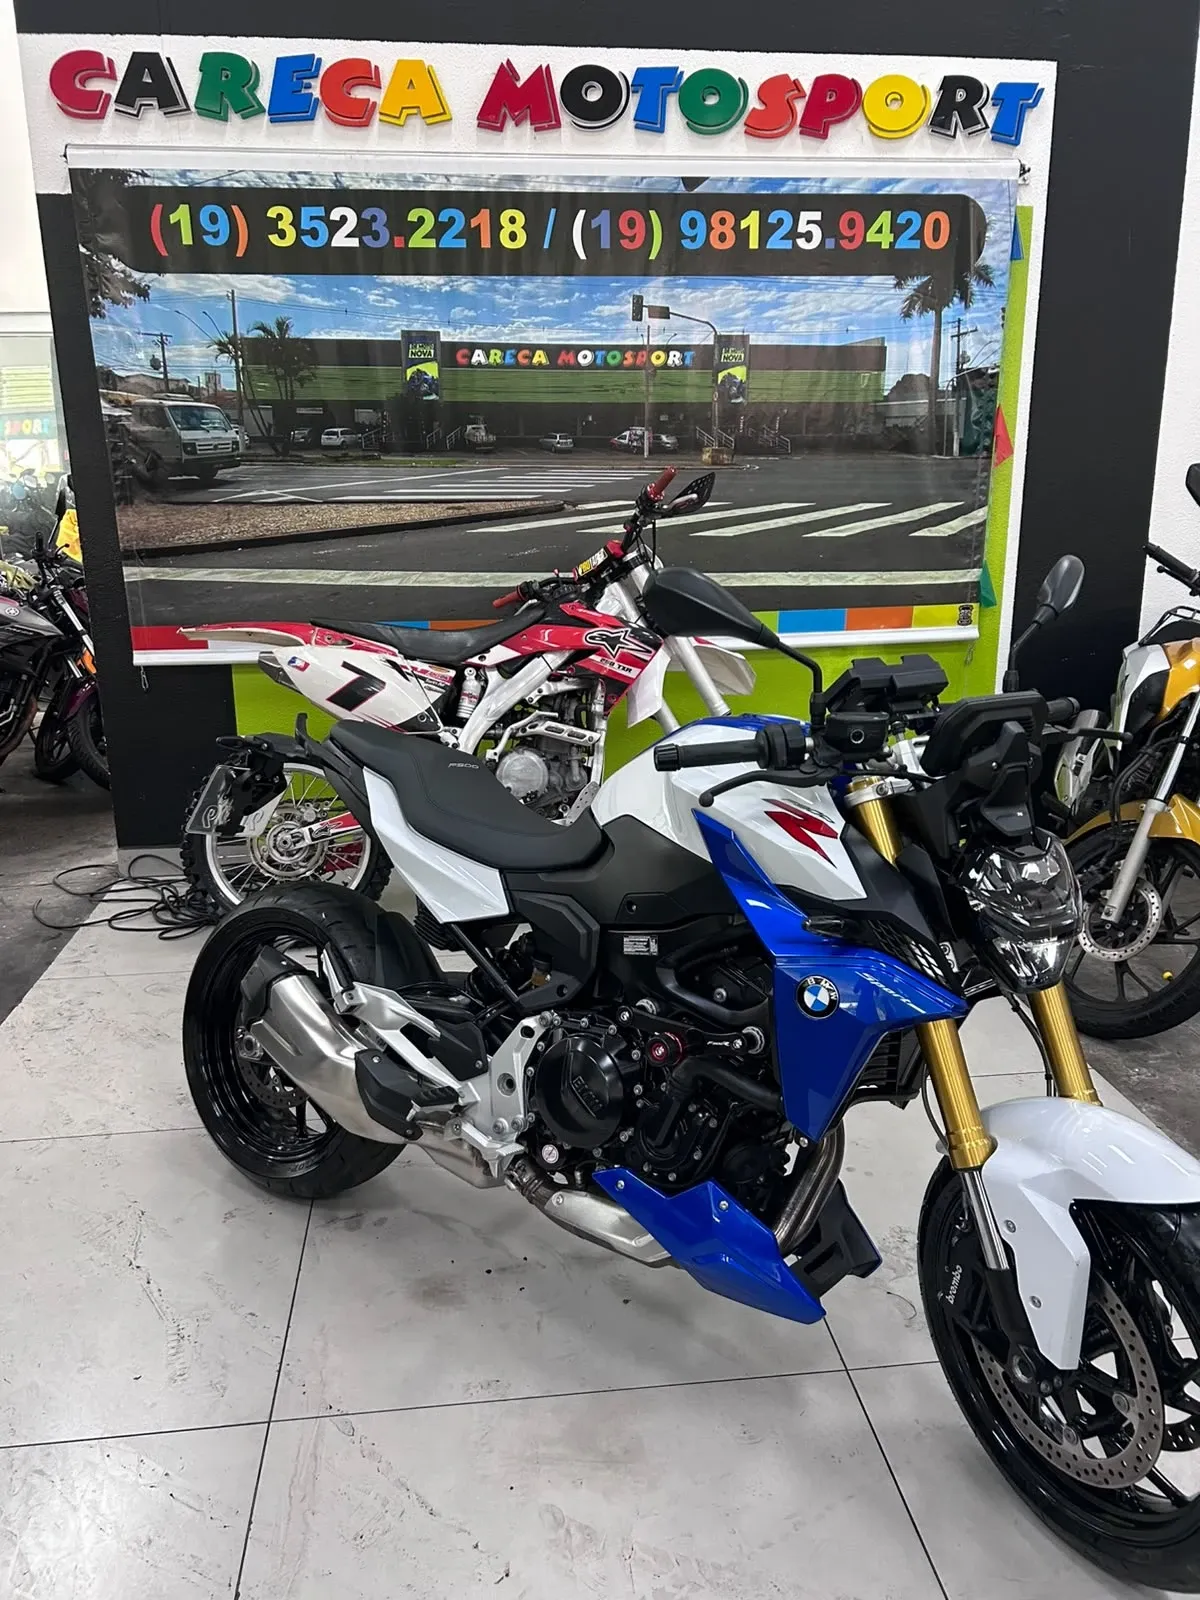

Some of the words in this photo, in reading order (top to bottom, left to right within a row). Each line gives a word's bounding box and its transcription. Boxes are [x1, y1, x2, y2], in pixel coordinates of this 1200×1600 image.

[49, 49, 453, 127] CARECA
[476, 58, 1045, 147] MOTOSPORT
[150, 203, 249, 257] (19)
[267, 205, 527, 249] 3523.2218
[542, 208, 557, 249] /
[572, 209, 663, 260] (19)
[680, 209, 951, 251] 98125.9420
[456, 348, 550, 367] CARECA
[557, 349, 696, 368] MOTOSPORT
[722, 353, 743, 361] NOVA
[945, 1264, 963, 1305] brembo
